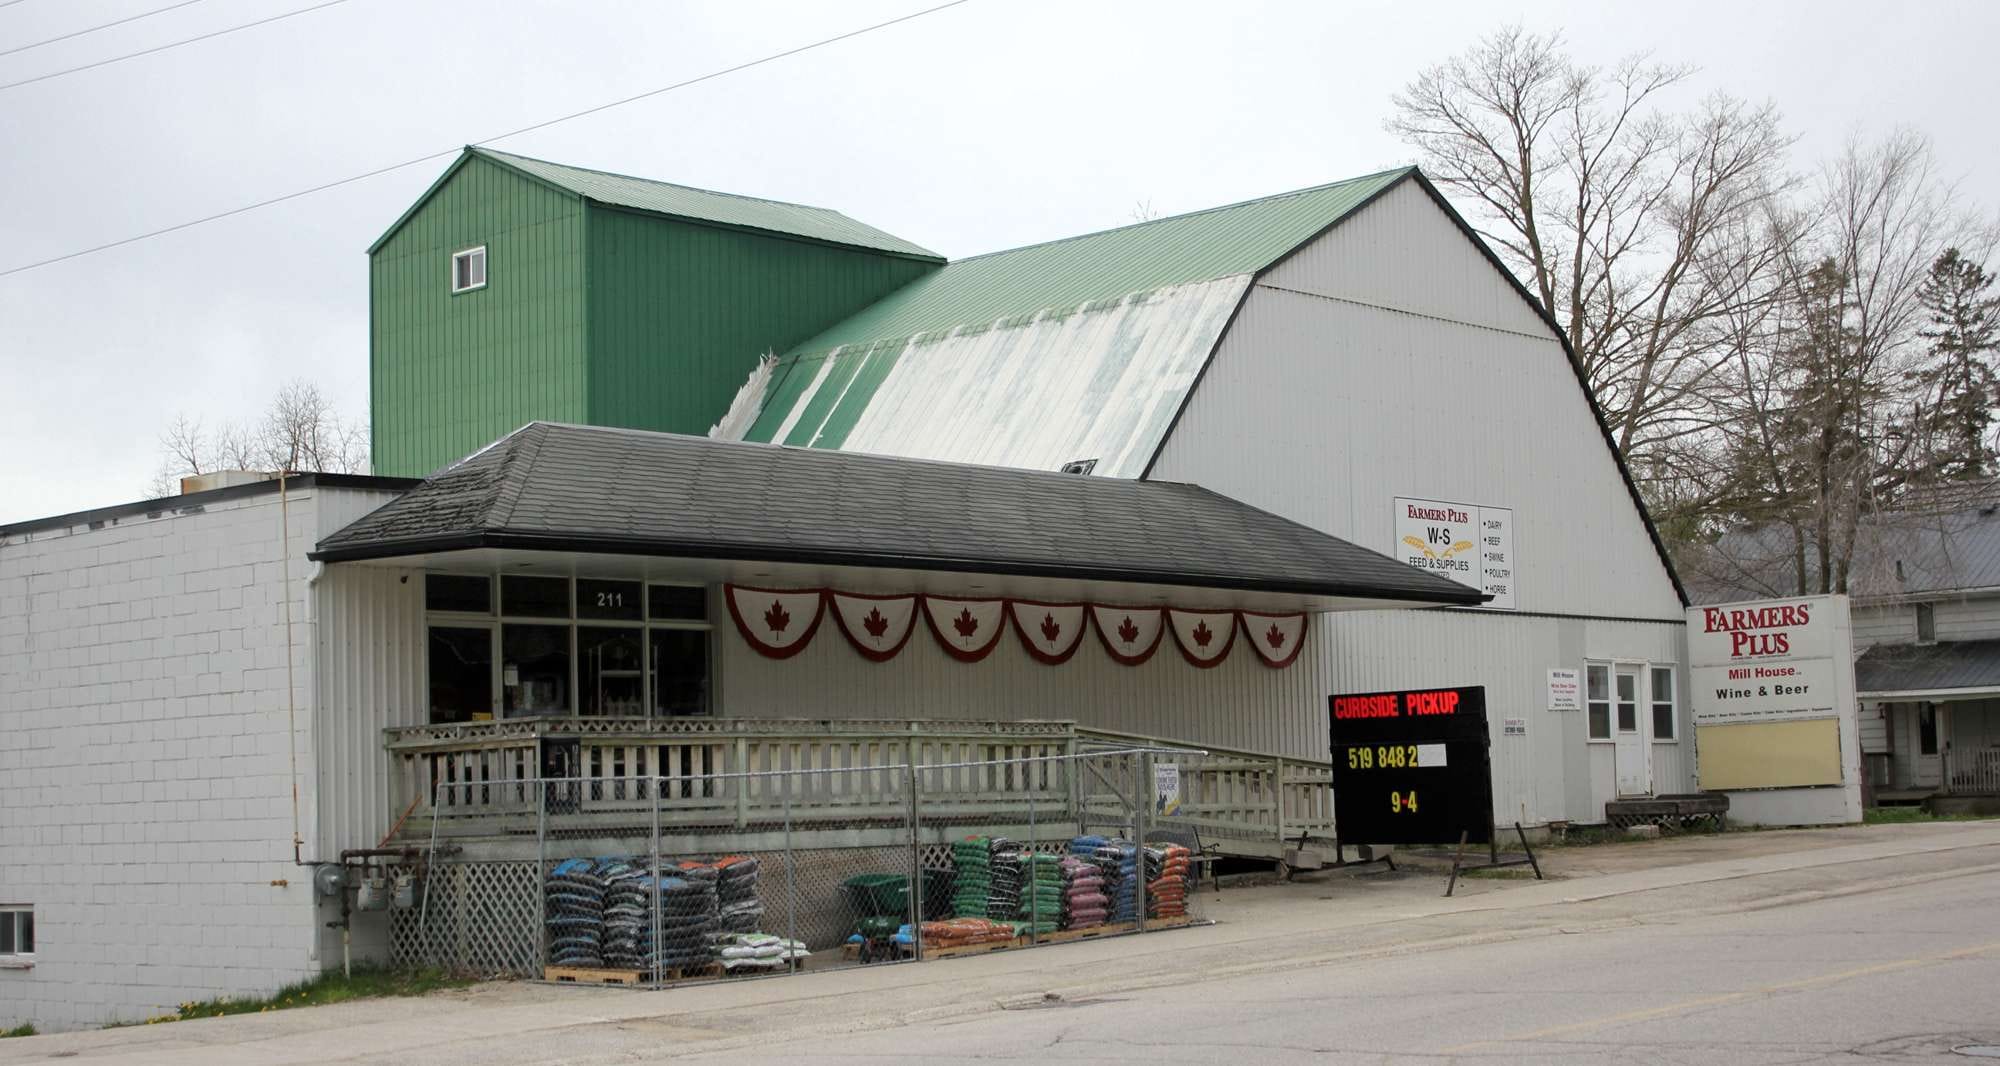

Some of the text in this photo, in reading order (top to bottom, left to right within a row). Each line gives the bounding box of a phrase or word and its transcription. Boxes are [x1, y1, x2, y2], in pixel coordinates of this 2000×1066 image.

[1407, 504, 1468, 524] FARMERS PLUS
[1427, 526, 1451, 545] W-S
[1409, 556, 1470, 571] FEED & SUPPLIES
[1489, 584, 1507, 595] HORSE
[597, 592, 622, 607] 211
[1703, 604, 1810, 633] FARMERS
[1730, 631, 1790, 657] PLUS
[1728, 668, 1751, 680] Mill
[1755, 666, 1796, 678] House
[1716, 684, 1809, 699] Wine & Beer
[1334, 691, 1459, 719] CURBSIDE PICKUP
[1348, 747, 1373, 769] 519
[1378, 746, 1405, 768] 848
[1391, 791, 1417, 813] 9-4
